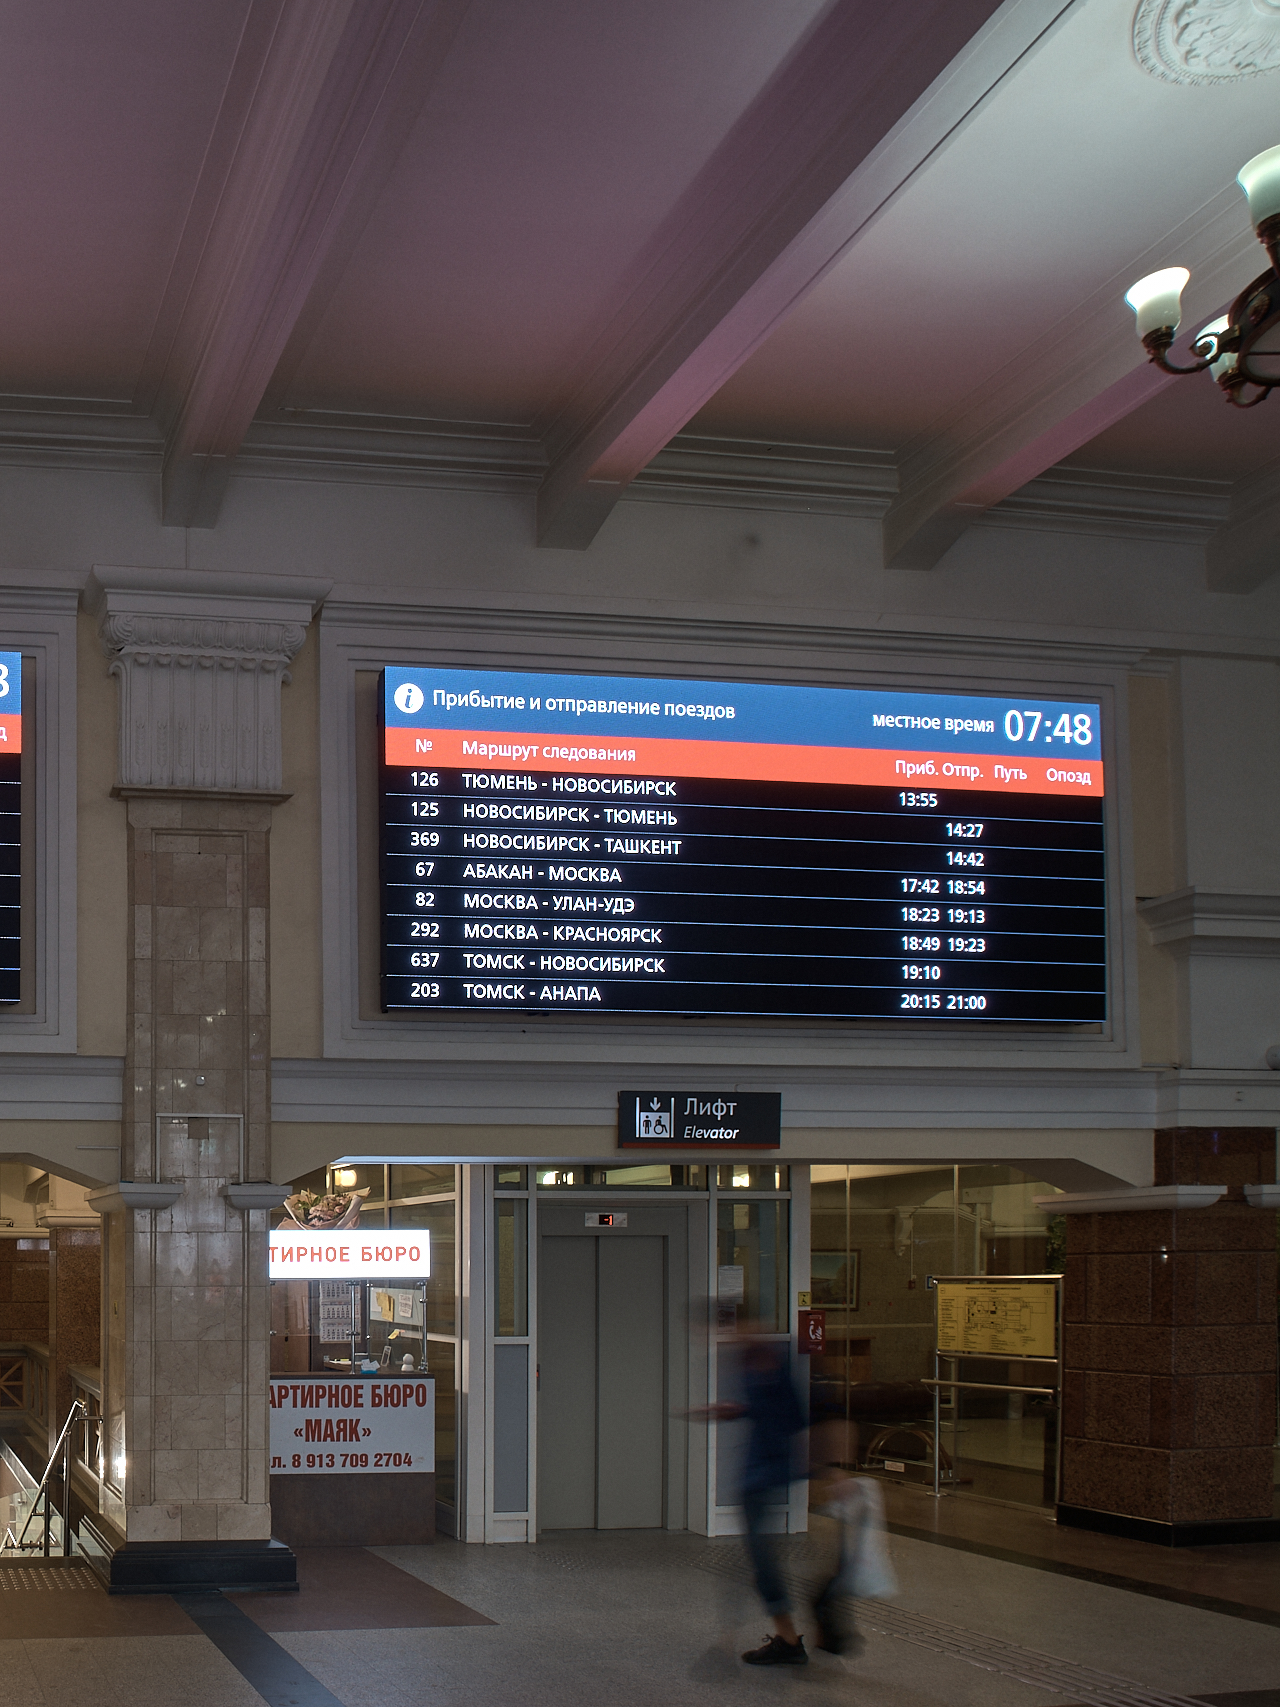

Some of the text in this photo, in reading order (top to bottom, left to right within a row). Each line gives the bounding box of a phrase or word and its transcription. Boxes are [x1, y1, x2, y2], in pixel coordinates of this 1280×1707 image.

[433, 689, 736, 721] Прибытие и отправление поездов
[872, 709, 1093, 746] местное время 07:48
[415, 738, 1093, 786] № Маршрут следования Приб. Отпр. Путь Опозд
[410, 771, 939, 808] 126 ТЮМЕНЬ НОВОСИБИРСК 13:55
[415, 891, 986, 924] 82 МОСКВА УЛАН-УДЭ 18:23 19:13
[410, 982, 987, 1011] 203 ТОМСК АНАПА 20:15 21:00
[683, 1097, 737, 1121] Лифт
[683, 1125, 740, 1139] Elevator
[269, 1245, 421, 1262] ТИРНОЕ БЮРО
[371, 1383, 427, 1408] БЮРО
[293, 1418, 372, 1443] «МАЯК»
[269, 1452, 413, 1468] л. 8 913 709 2704
